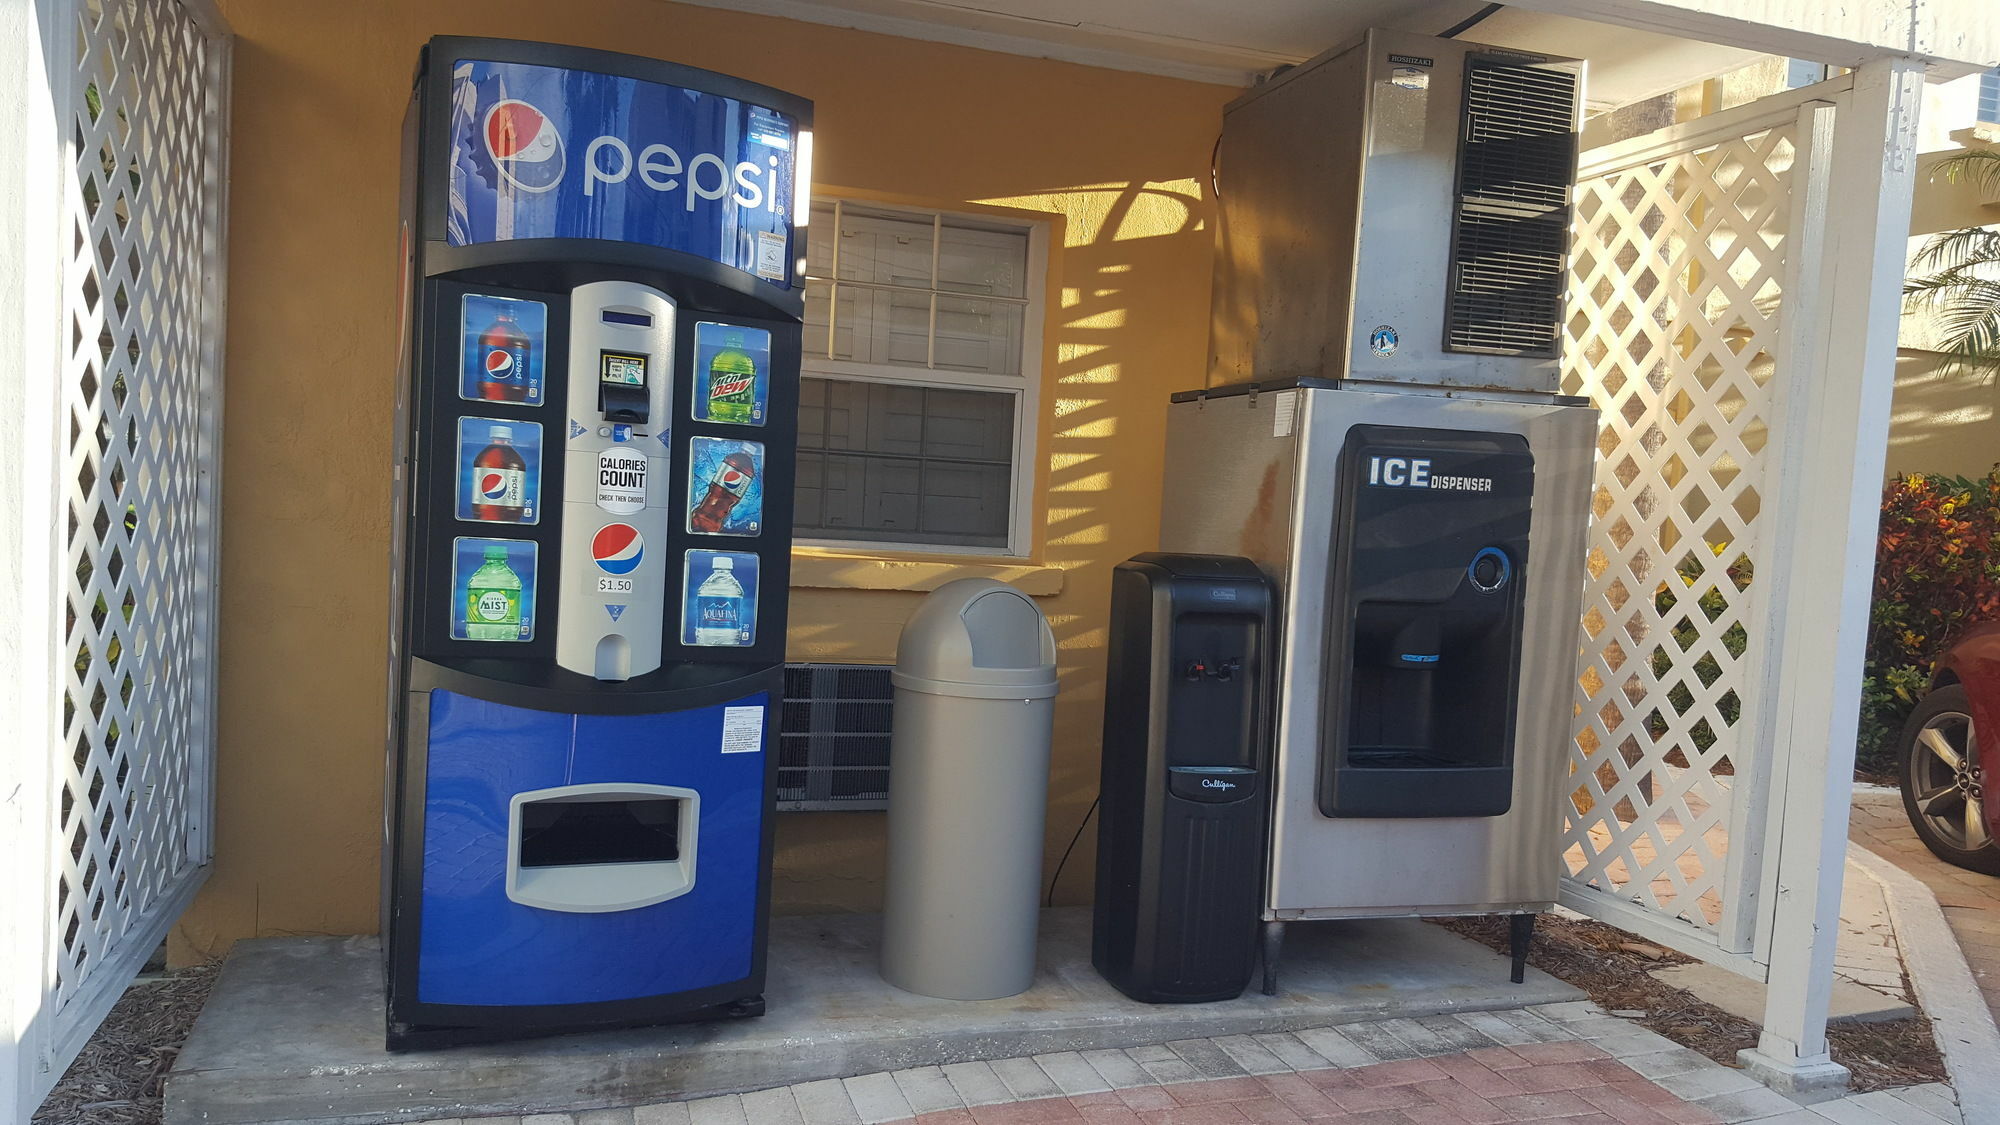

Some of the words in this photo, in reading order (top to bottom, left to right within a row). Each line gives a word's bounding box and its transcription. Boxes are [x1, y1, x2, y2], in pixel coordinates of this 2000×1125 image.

[1391, 55, 1431, 66] HOSHIZAKI
[515, 353, 523, 380] pepsi
[600, 457, 646, 472] CALORIES
[1369, 456, 1431, 487] ICE
[1430, 475, 1492, 492] DISPENSER
[627, 496, 645, 504] CHOOSE
[599, 578, 632, 591] $1.50
[480, 600, 507, 610] MIST
[703, 607, 737, 621] AQUAFINA
[1201, 779, 1236, 791] Culligan
